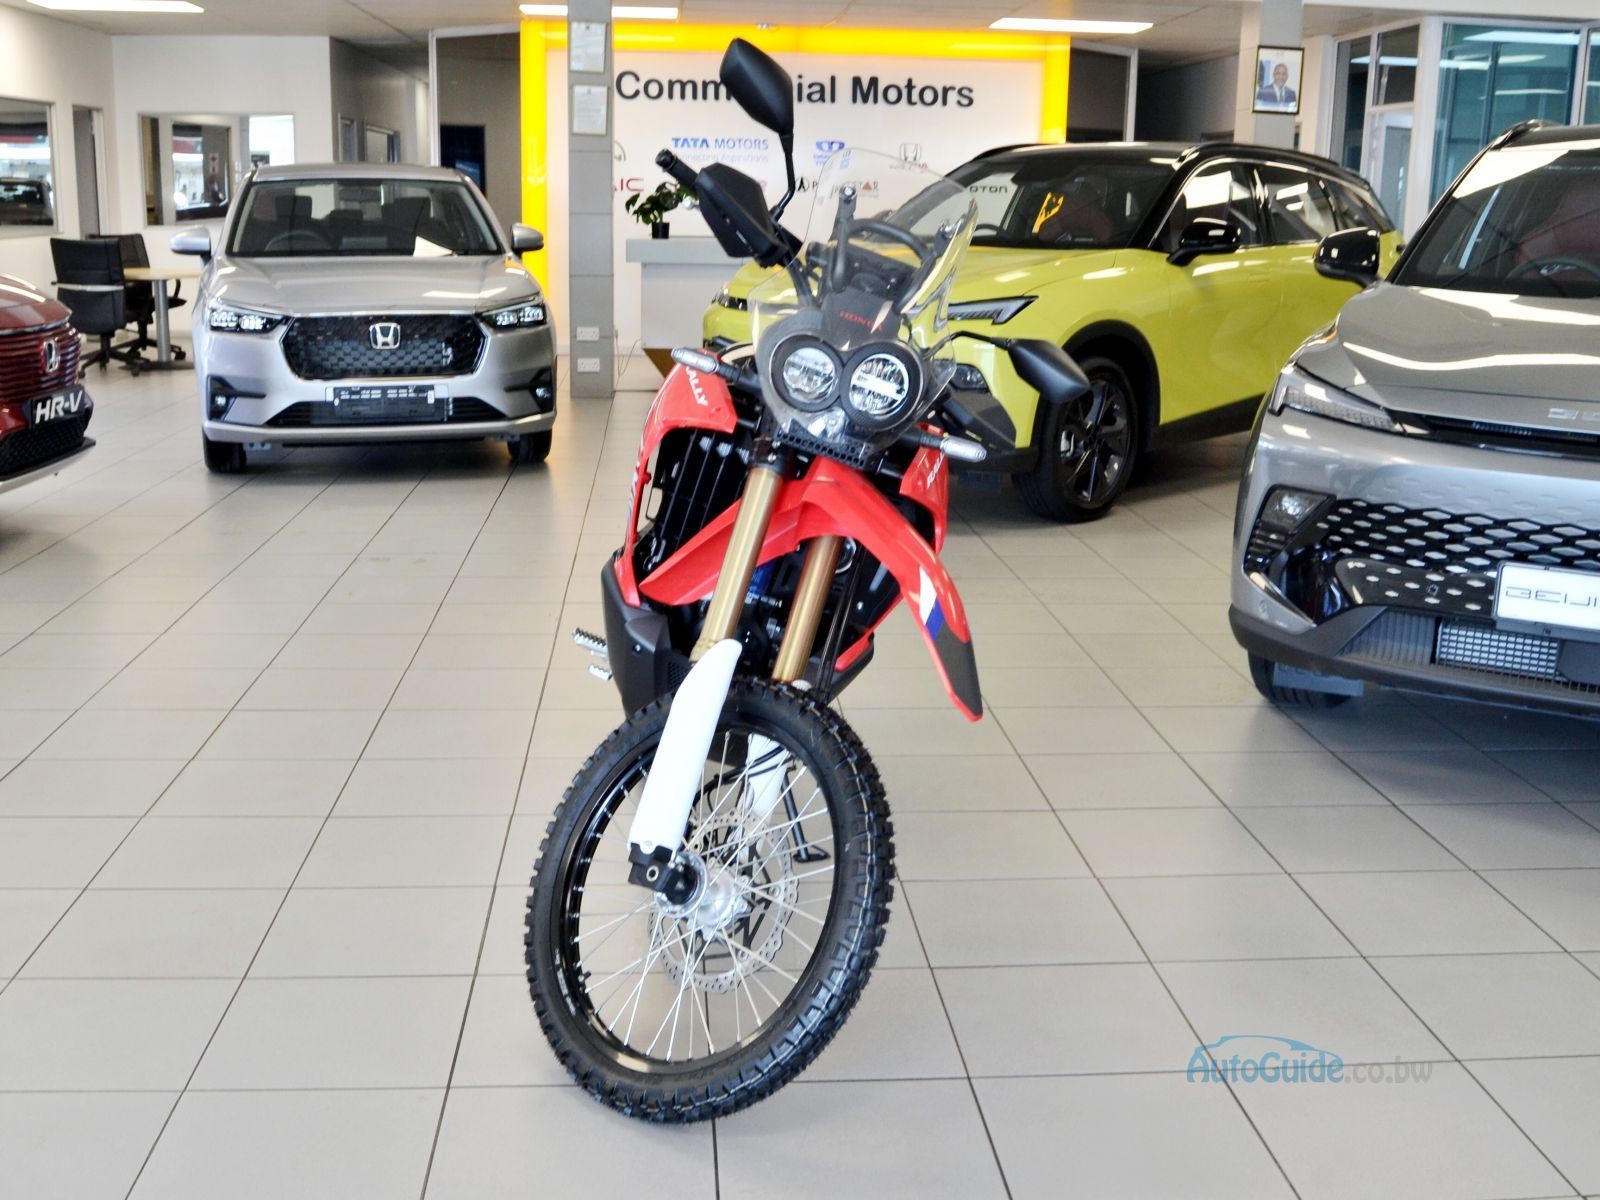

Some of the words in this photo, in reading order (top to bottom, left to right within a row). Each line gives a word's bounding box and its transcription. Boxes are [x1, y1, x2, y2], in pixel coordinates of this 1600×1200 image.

[615, 70, 837, 104] Commial
[851, 76, 975, 108] Motors
[671, 137, 710, 149] TATA
[714, 138, 769, 150] MOTORS
[35, 390, 83, 424] HR-V
[1505, 585, 1600, 608] BEIJI
